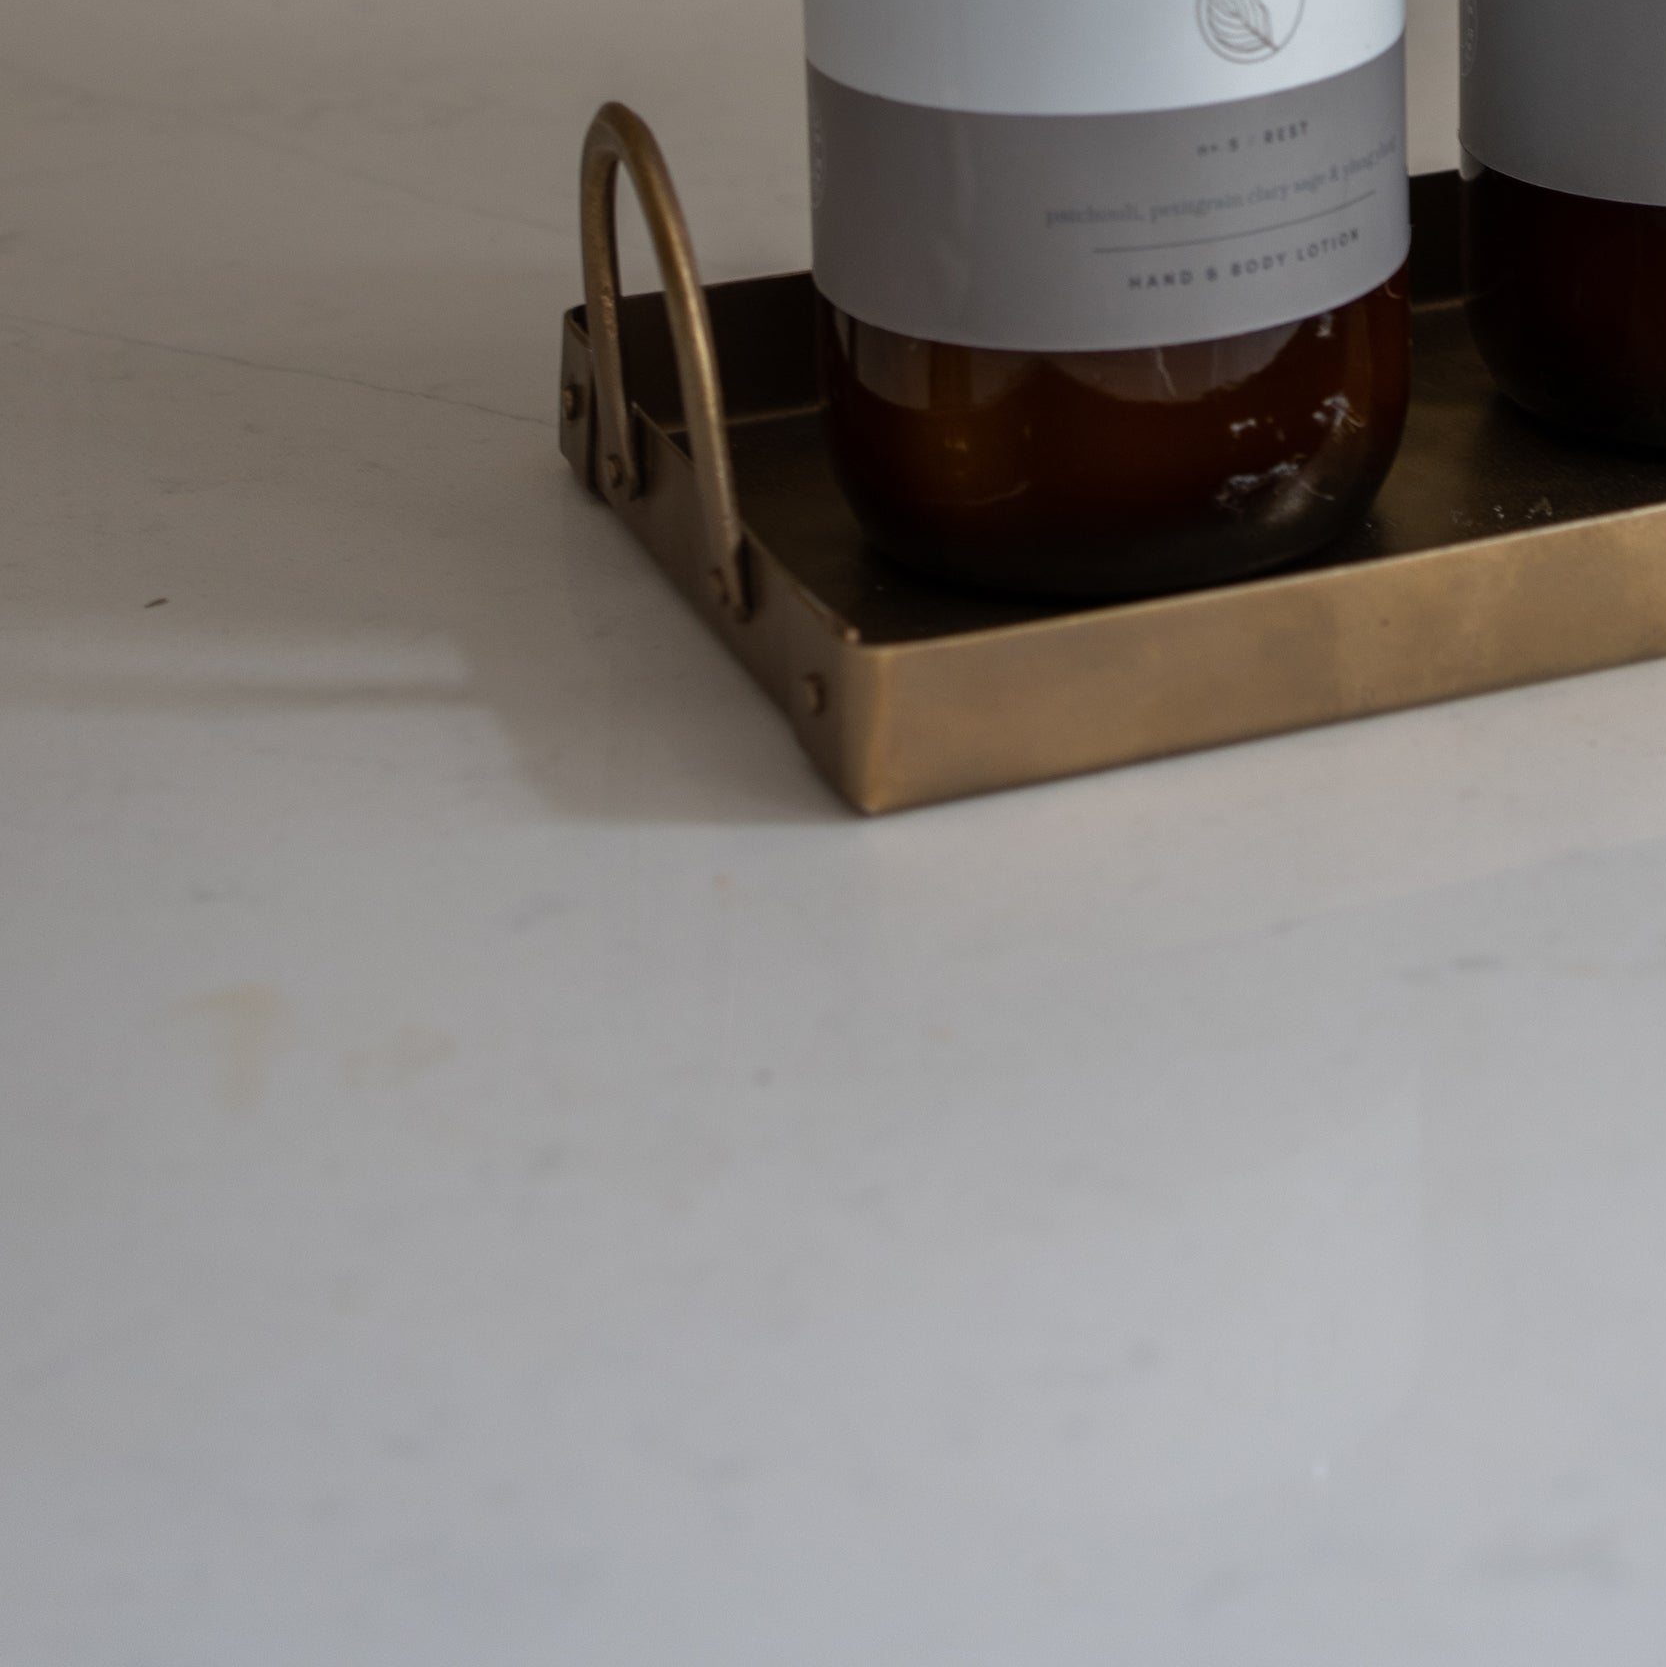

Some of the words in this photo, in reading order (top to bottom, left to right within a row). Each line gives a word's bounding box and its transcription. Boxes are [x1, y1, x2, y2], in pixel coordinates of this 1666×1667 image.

[1262, 119, 1309, 145] REST
[1128, 269, 1194, 289] HAND
[1231, 250, 1287, 278] BODY
[1297, 227, 1359, 262] LOTION
